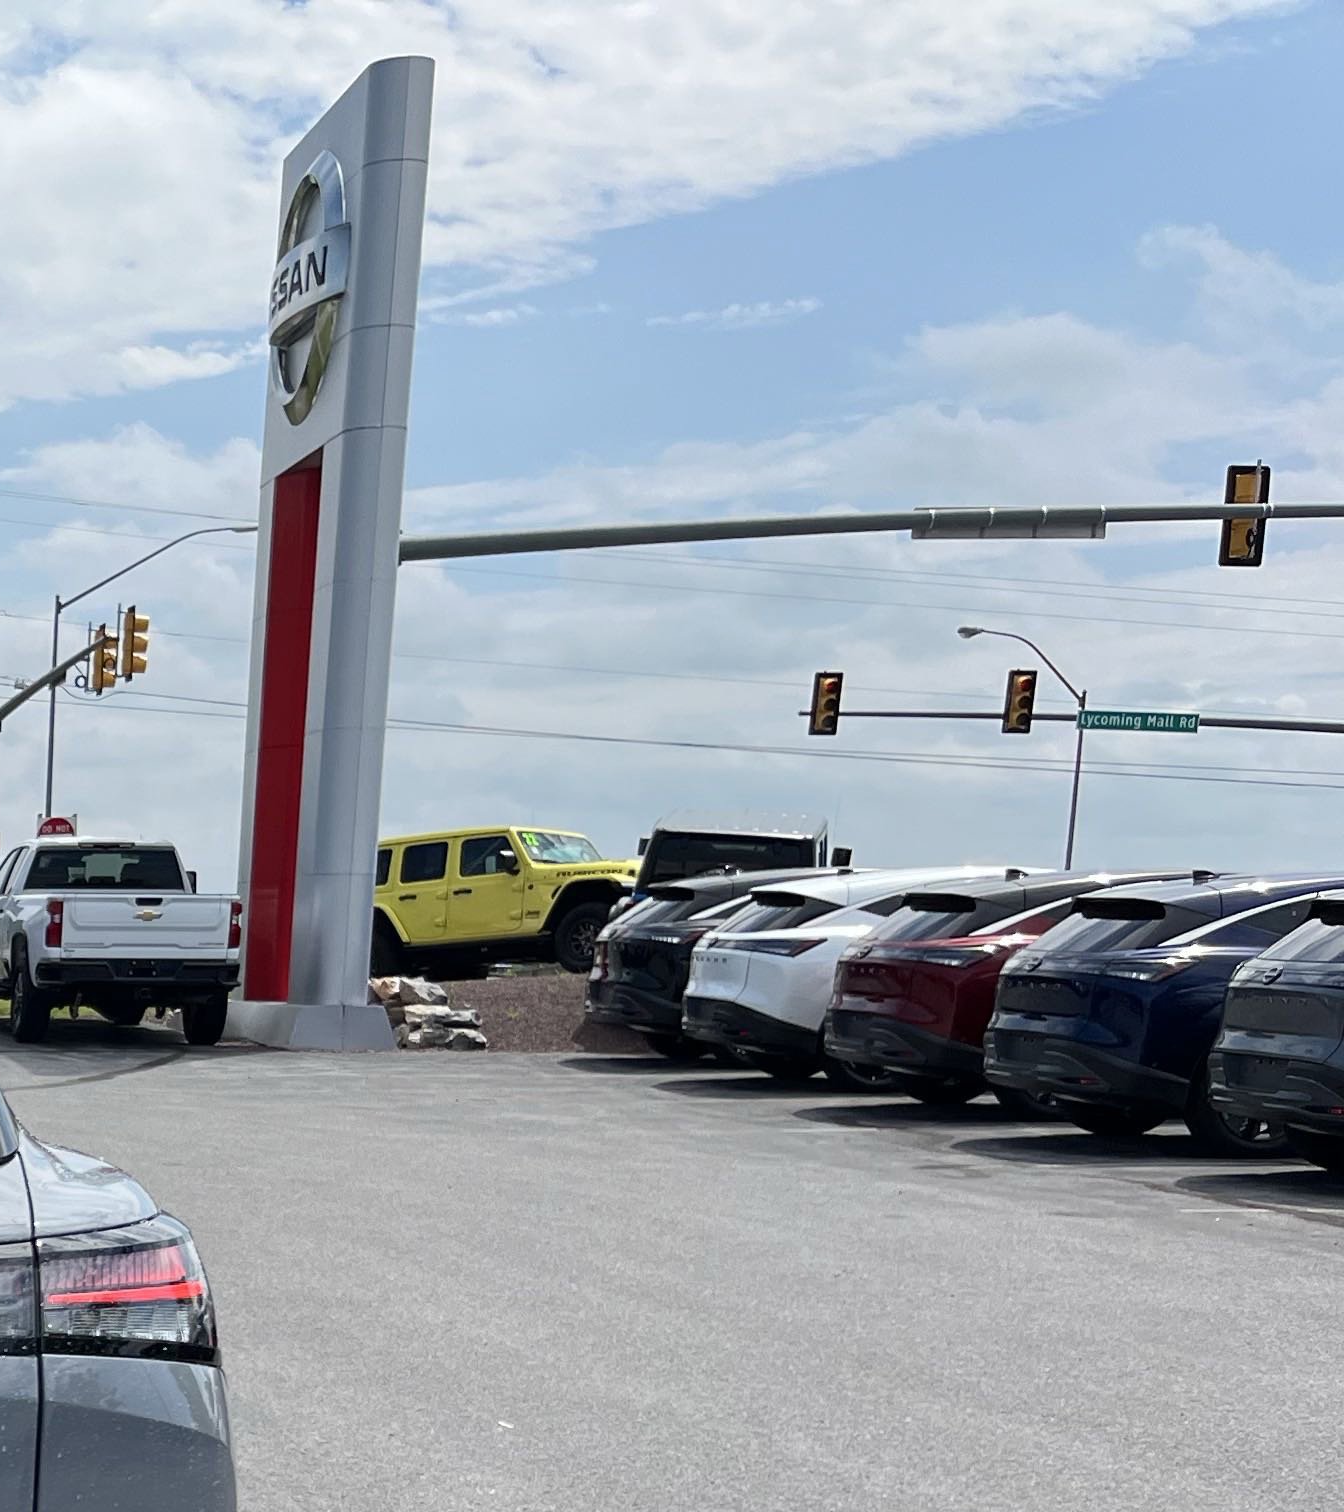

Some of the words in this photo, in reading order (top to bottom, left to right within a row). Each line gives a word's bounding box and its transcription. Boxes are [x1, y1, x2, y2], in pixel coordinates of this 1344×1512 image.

[1081, 712, 1142, 729] Lycoming
[1146, 714, 1174, 728] Mall
[1179, 716, 1196, 728] Rd
